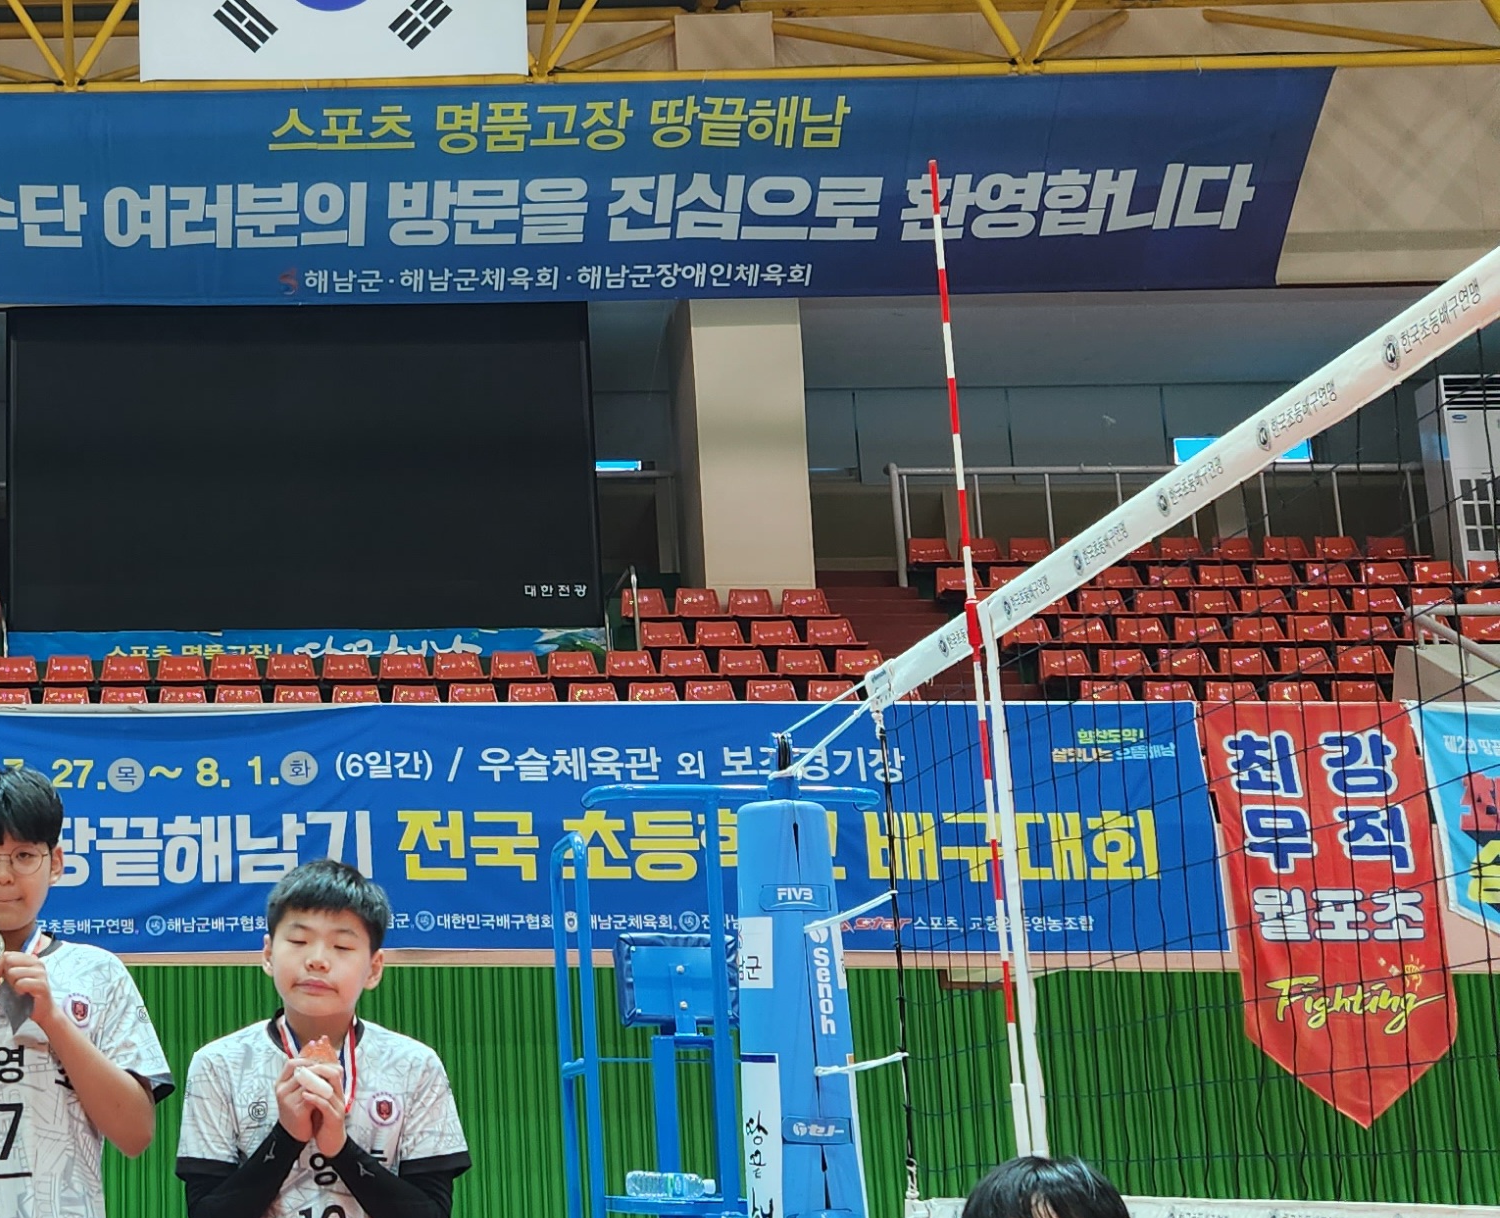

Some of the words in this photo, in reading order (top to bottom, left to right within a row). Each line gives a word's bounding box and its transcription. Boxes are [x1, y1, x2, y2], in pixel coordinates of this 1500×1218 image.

[268, 104, 416, 152] 스포츠
[435, 97, 633, 154] 명품고장
[649, 94, 851, 152] 땅끝해남
[103, 182, 368, 249] 여러분의
[388, 176, 589, 247] 방문을
[606, 172, 885, 241] 진심으로
[899, 162, 1256, 241] 환영합니다
[334, 749, 434, 782] (6일간)
[477, 746, 662, 783] 우슬체육관
[676, 750, 706, 780] 외
[397, 809, 540, 882] 전국
[864, 808, 1162, 884] 배구대회
[1244, 804, 1415, 874] 무적
[776, 887, 814, 901] FIVB
[1252, 885, 1425, 942] 월포초
[813, 947, 836, 1035] Senoh
[1264, 974, 1446, 1035] Fighting
